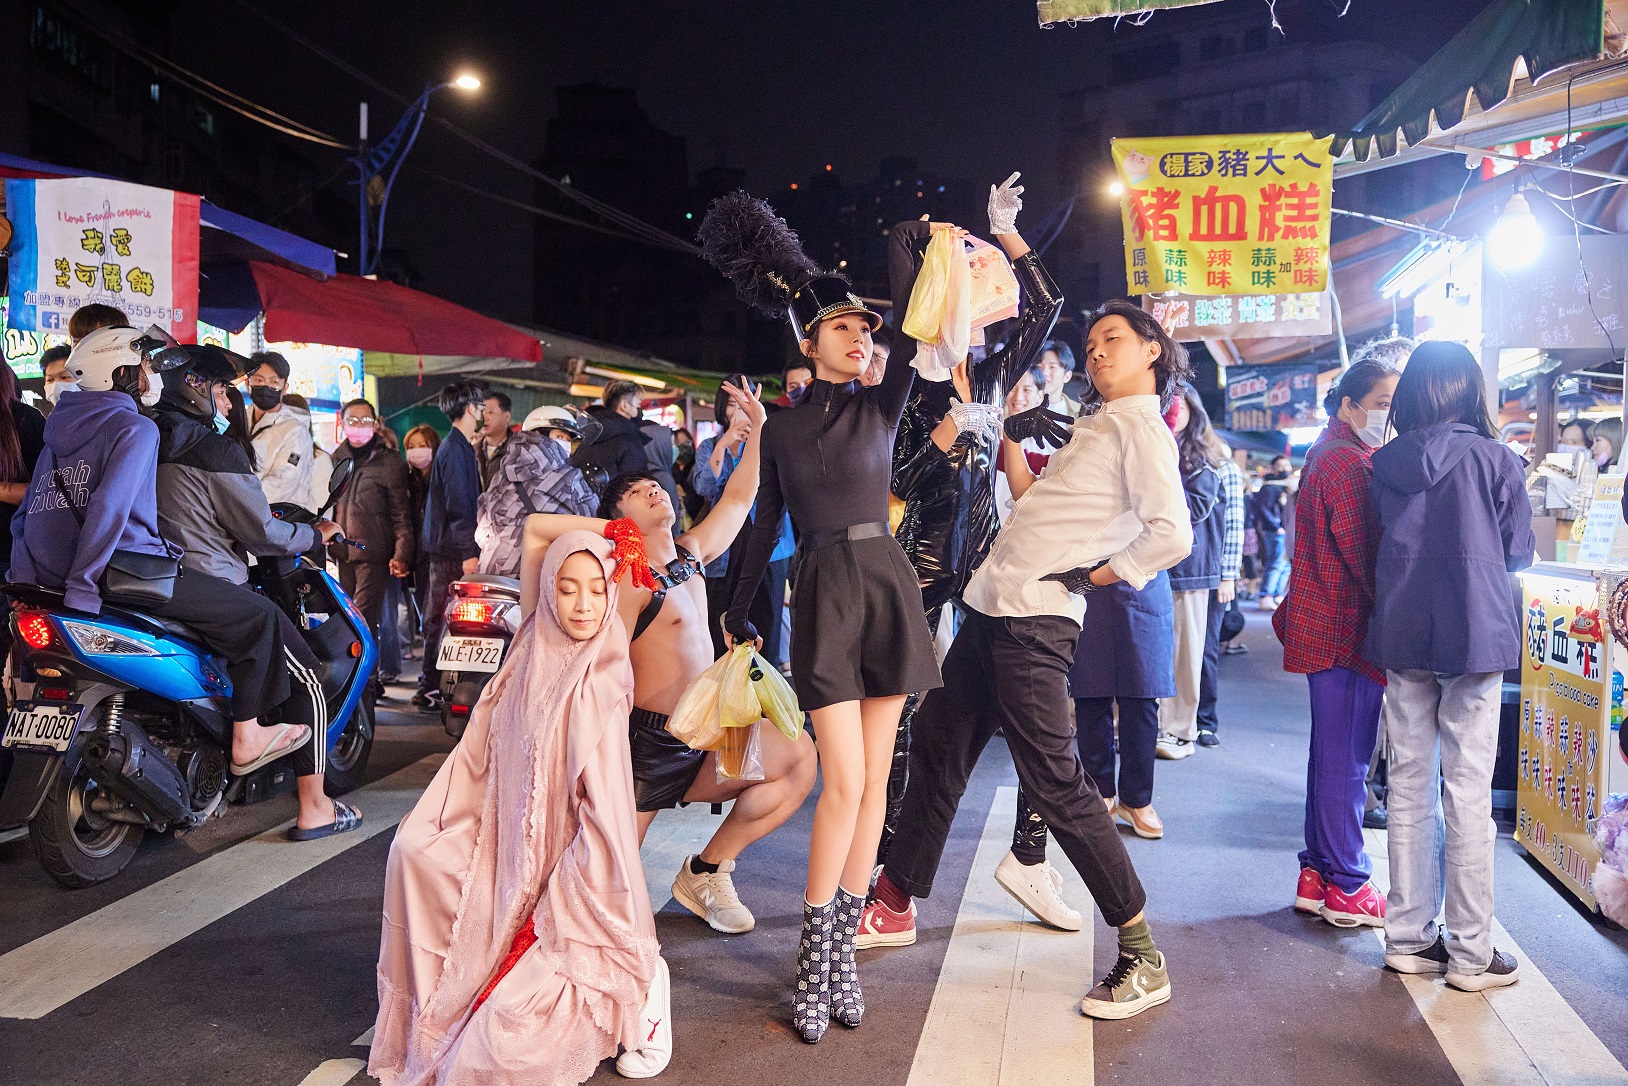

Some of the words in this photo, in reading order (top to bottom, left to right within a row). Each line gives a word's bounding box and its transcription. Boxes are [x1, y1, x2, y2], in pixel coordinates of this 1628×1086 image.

[1163, 153, 1210, 177] 楊家
[57, 210, 62, 221] I
[63, 211, 85, 224] love
[86, 211, 115, 223] French
[117, 207, 152, 220] creperie
[1127, 181, 1321, 243] 豬血糕
[80, 228, 132, 257] 我愛
[75, 262, 154, 297] 可麗餅
[1132, 247, 1150, 288] 原味
[1164, 248, 1188, 288] 蒜味
[1206, 248, 1232, 289] 辣味
[1251, 247, 1277, 289] 蒜味
[1278, 261, 1292, 274] 加
[1293, 246, 1320, 288] 辣味
[24, 290, 81, 309] 加盟專線
[1582, 689, 1599, 711] cake
